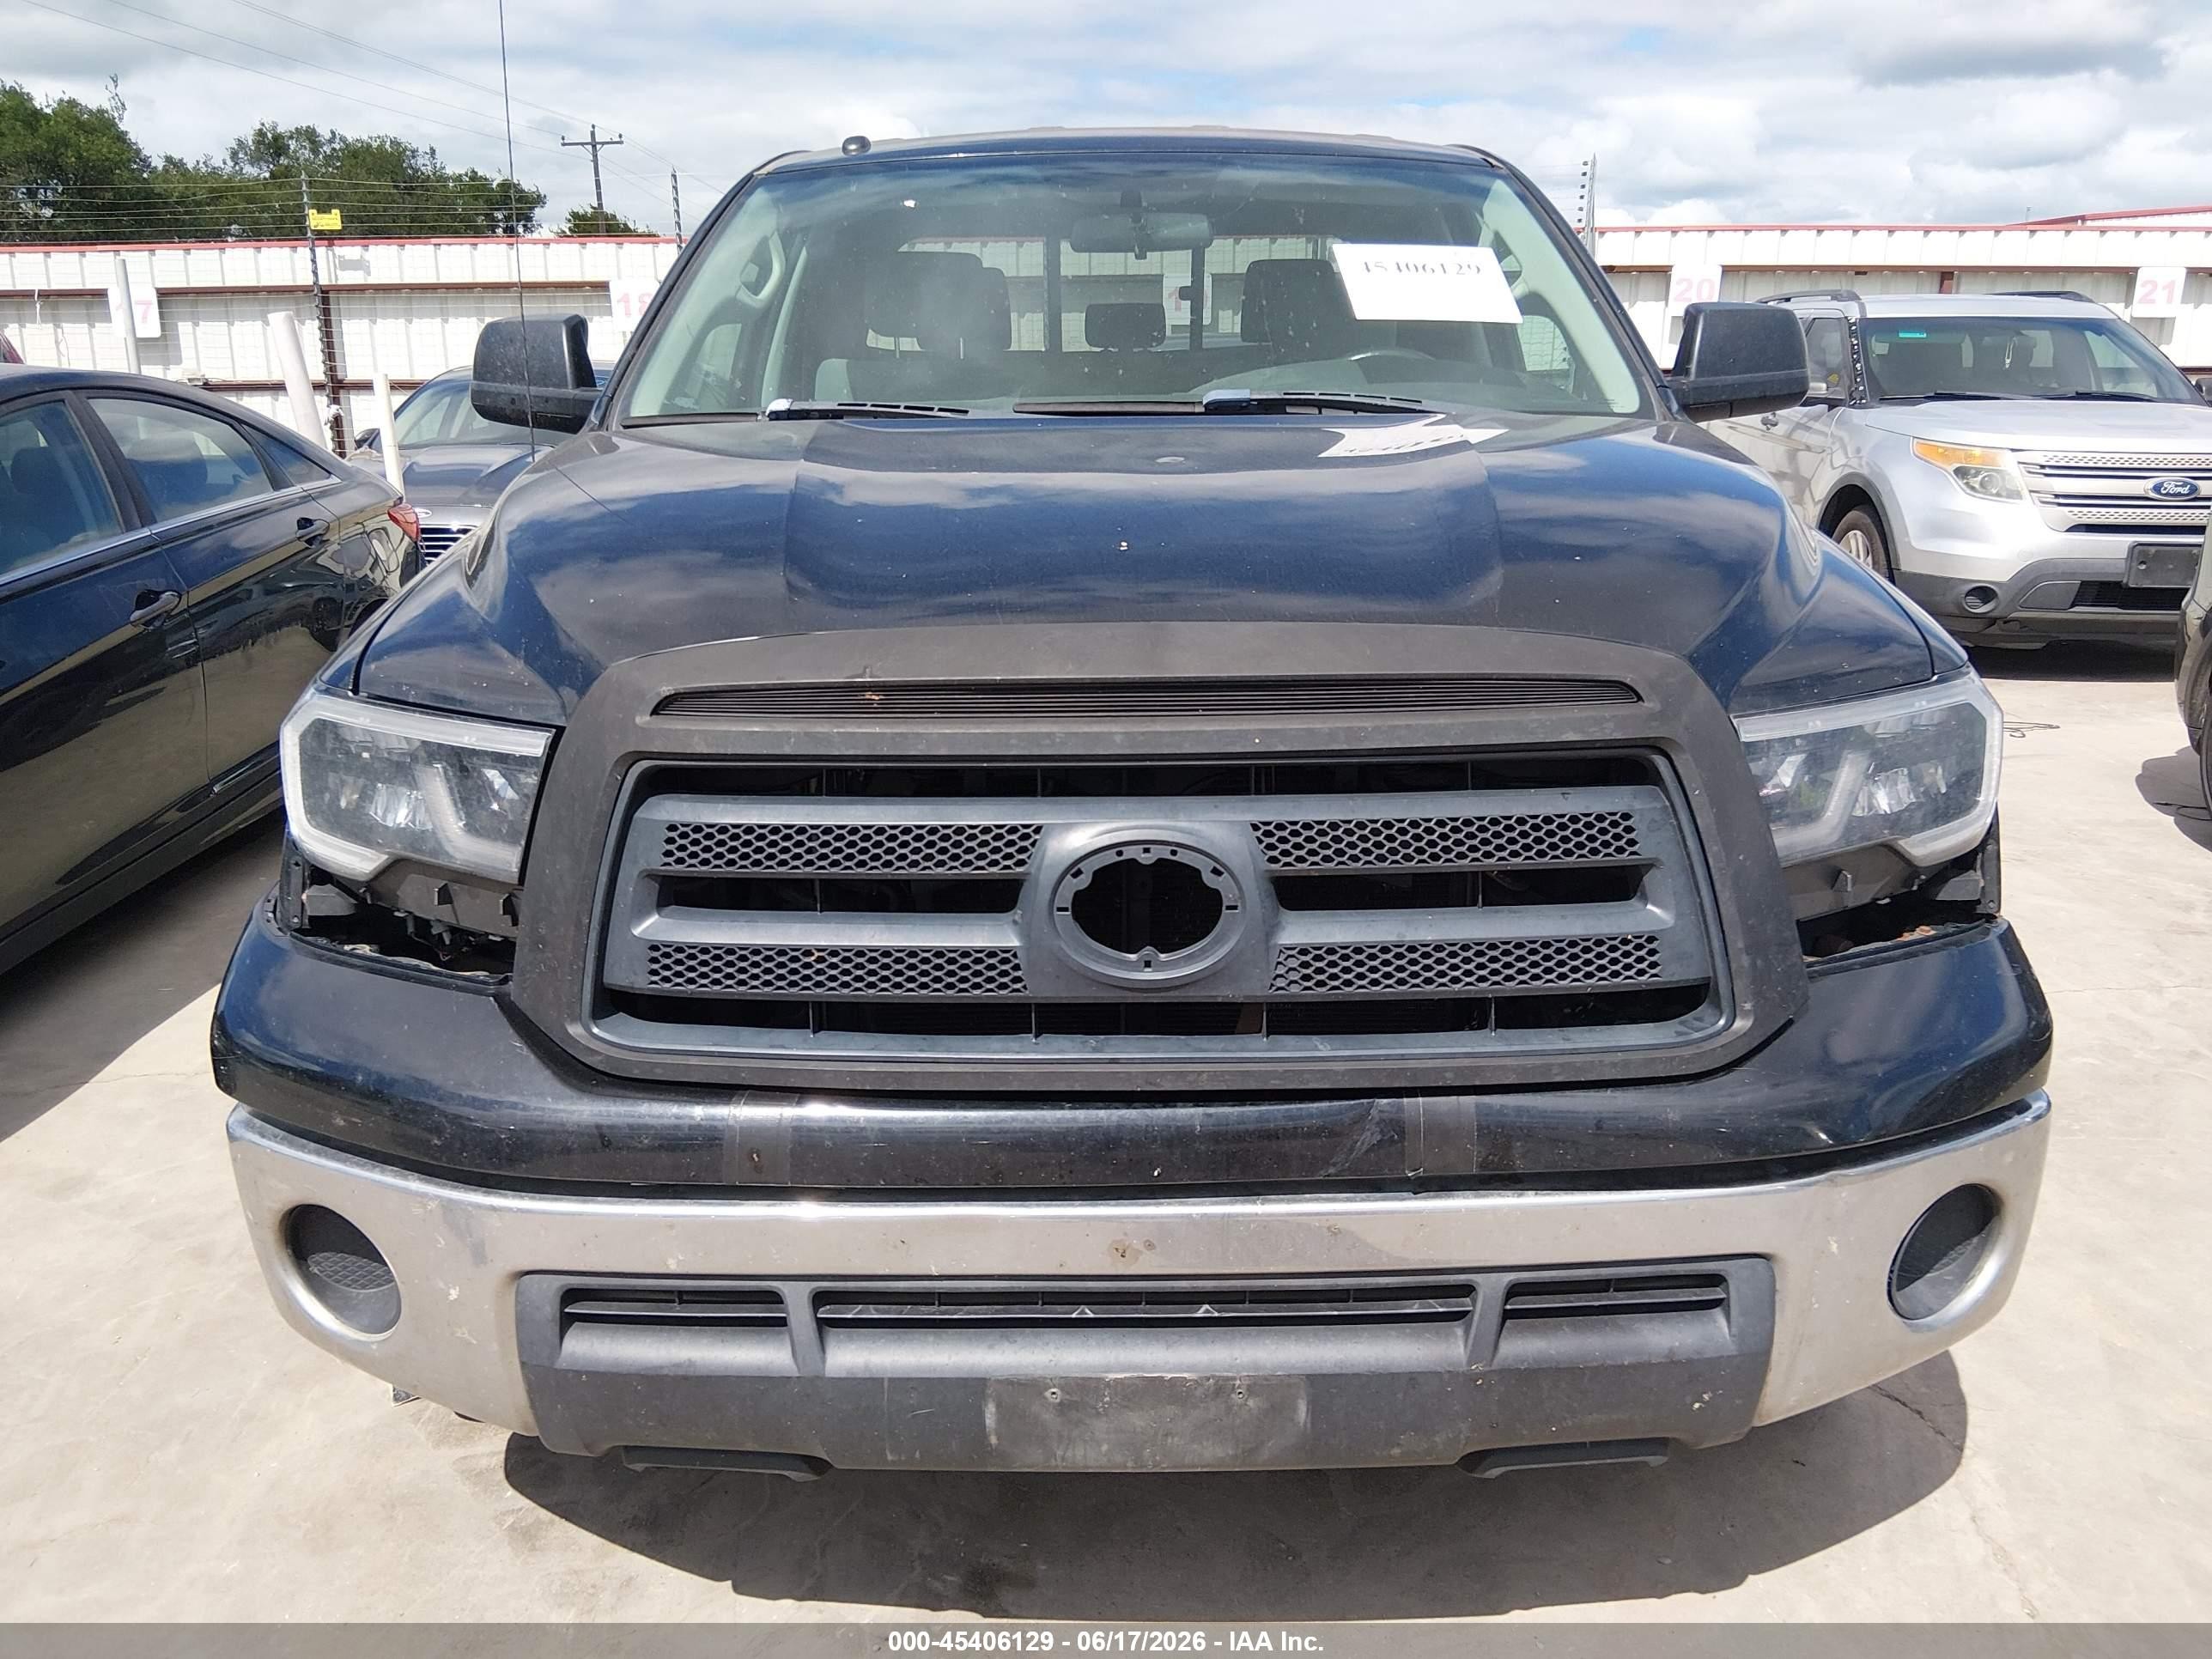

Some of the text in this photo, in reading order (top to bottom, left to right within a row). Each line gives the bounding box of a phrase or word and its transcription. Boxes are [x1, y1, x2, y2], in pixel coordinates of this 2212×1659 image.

[1674, 278, 1716, 302] 20
[2138, 280, 2175, 304] 21
[2160, 481, 2191, 494] Ford
